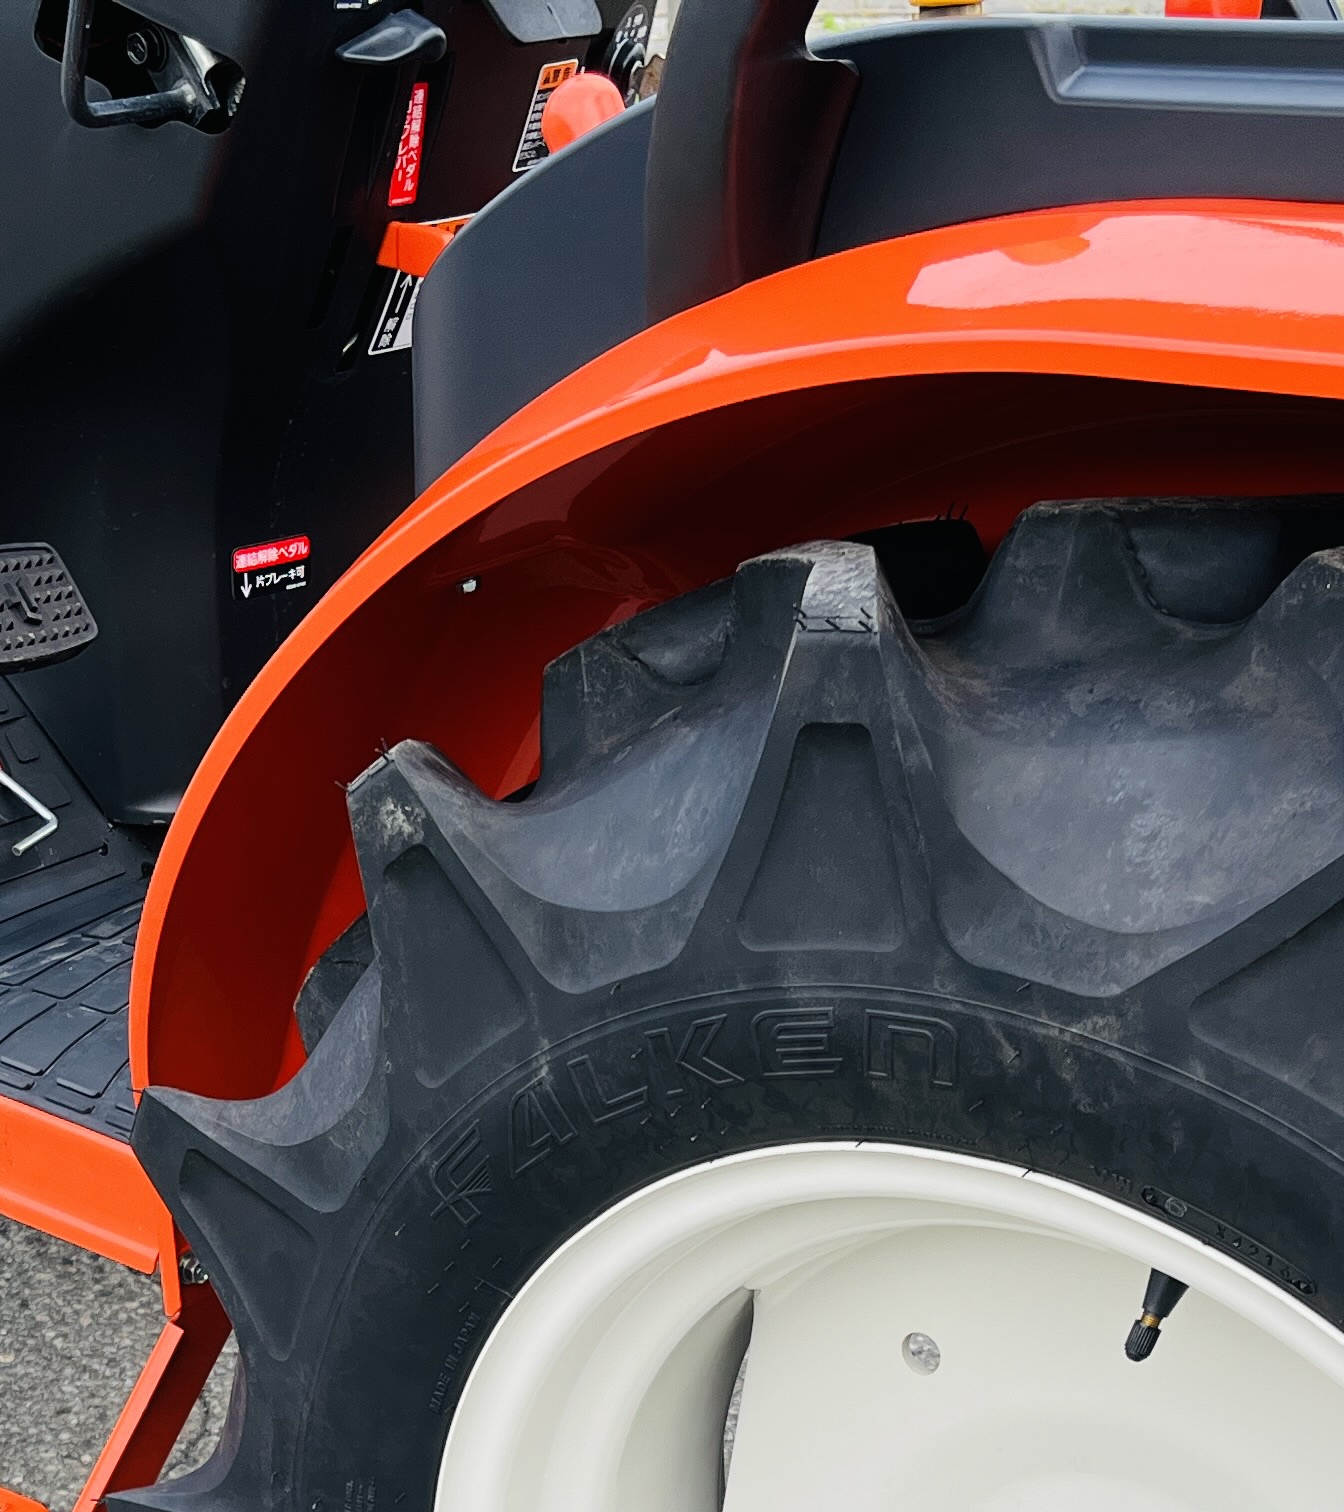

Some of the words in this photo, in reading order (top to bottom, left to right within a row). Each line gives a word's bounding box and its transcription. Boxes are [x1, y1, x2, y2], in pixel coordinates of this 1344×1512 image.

[430, 1005, 960, 1227] FALKEN
[428, 1371, 452, 1413] MADE
[442, 1352, 460, 1371] IN
[453, 1310, 481, 1354] JAPAN
